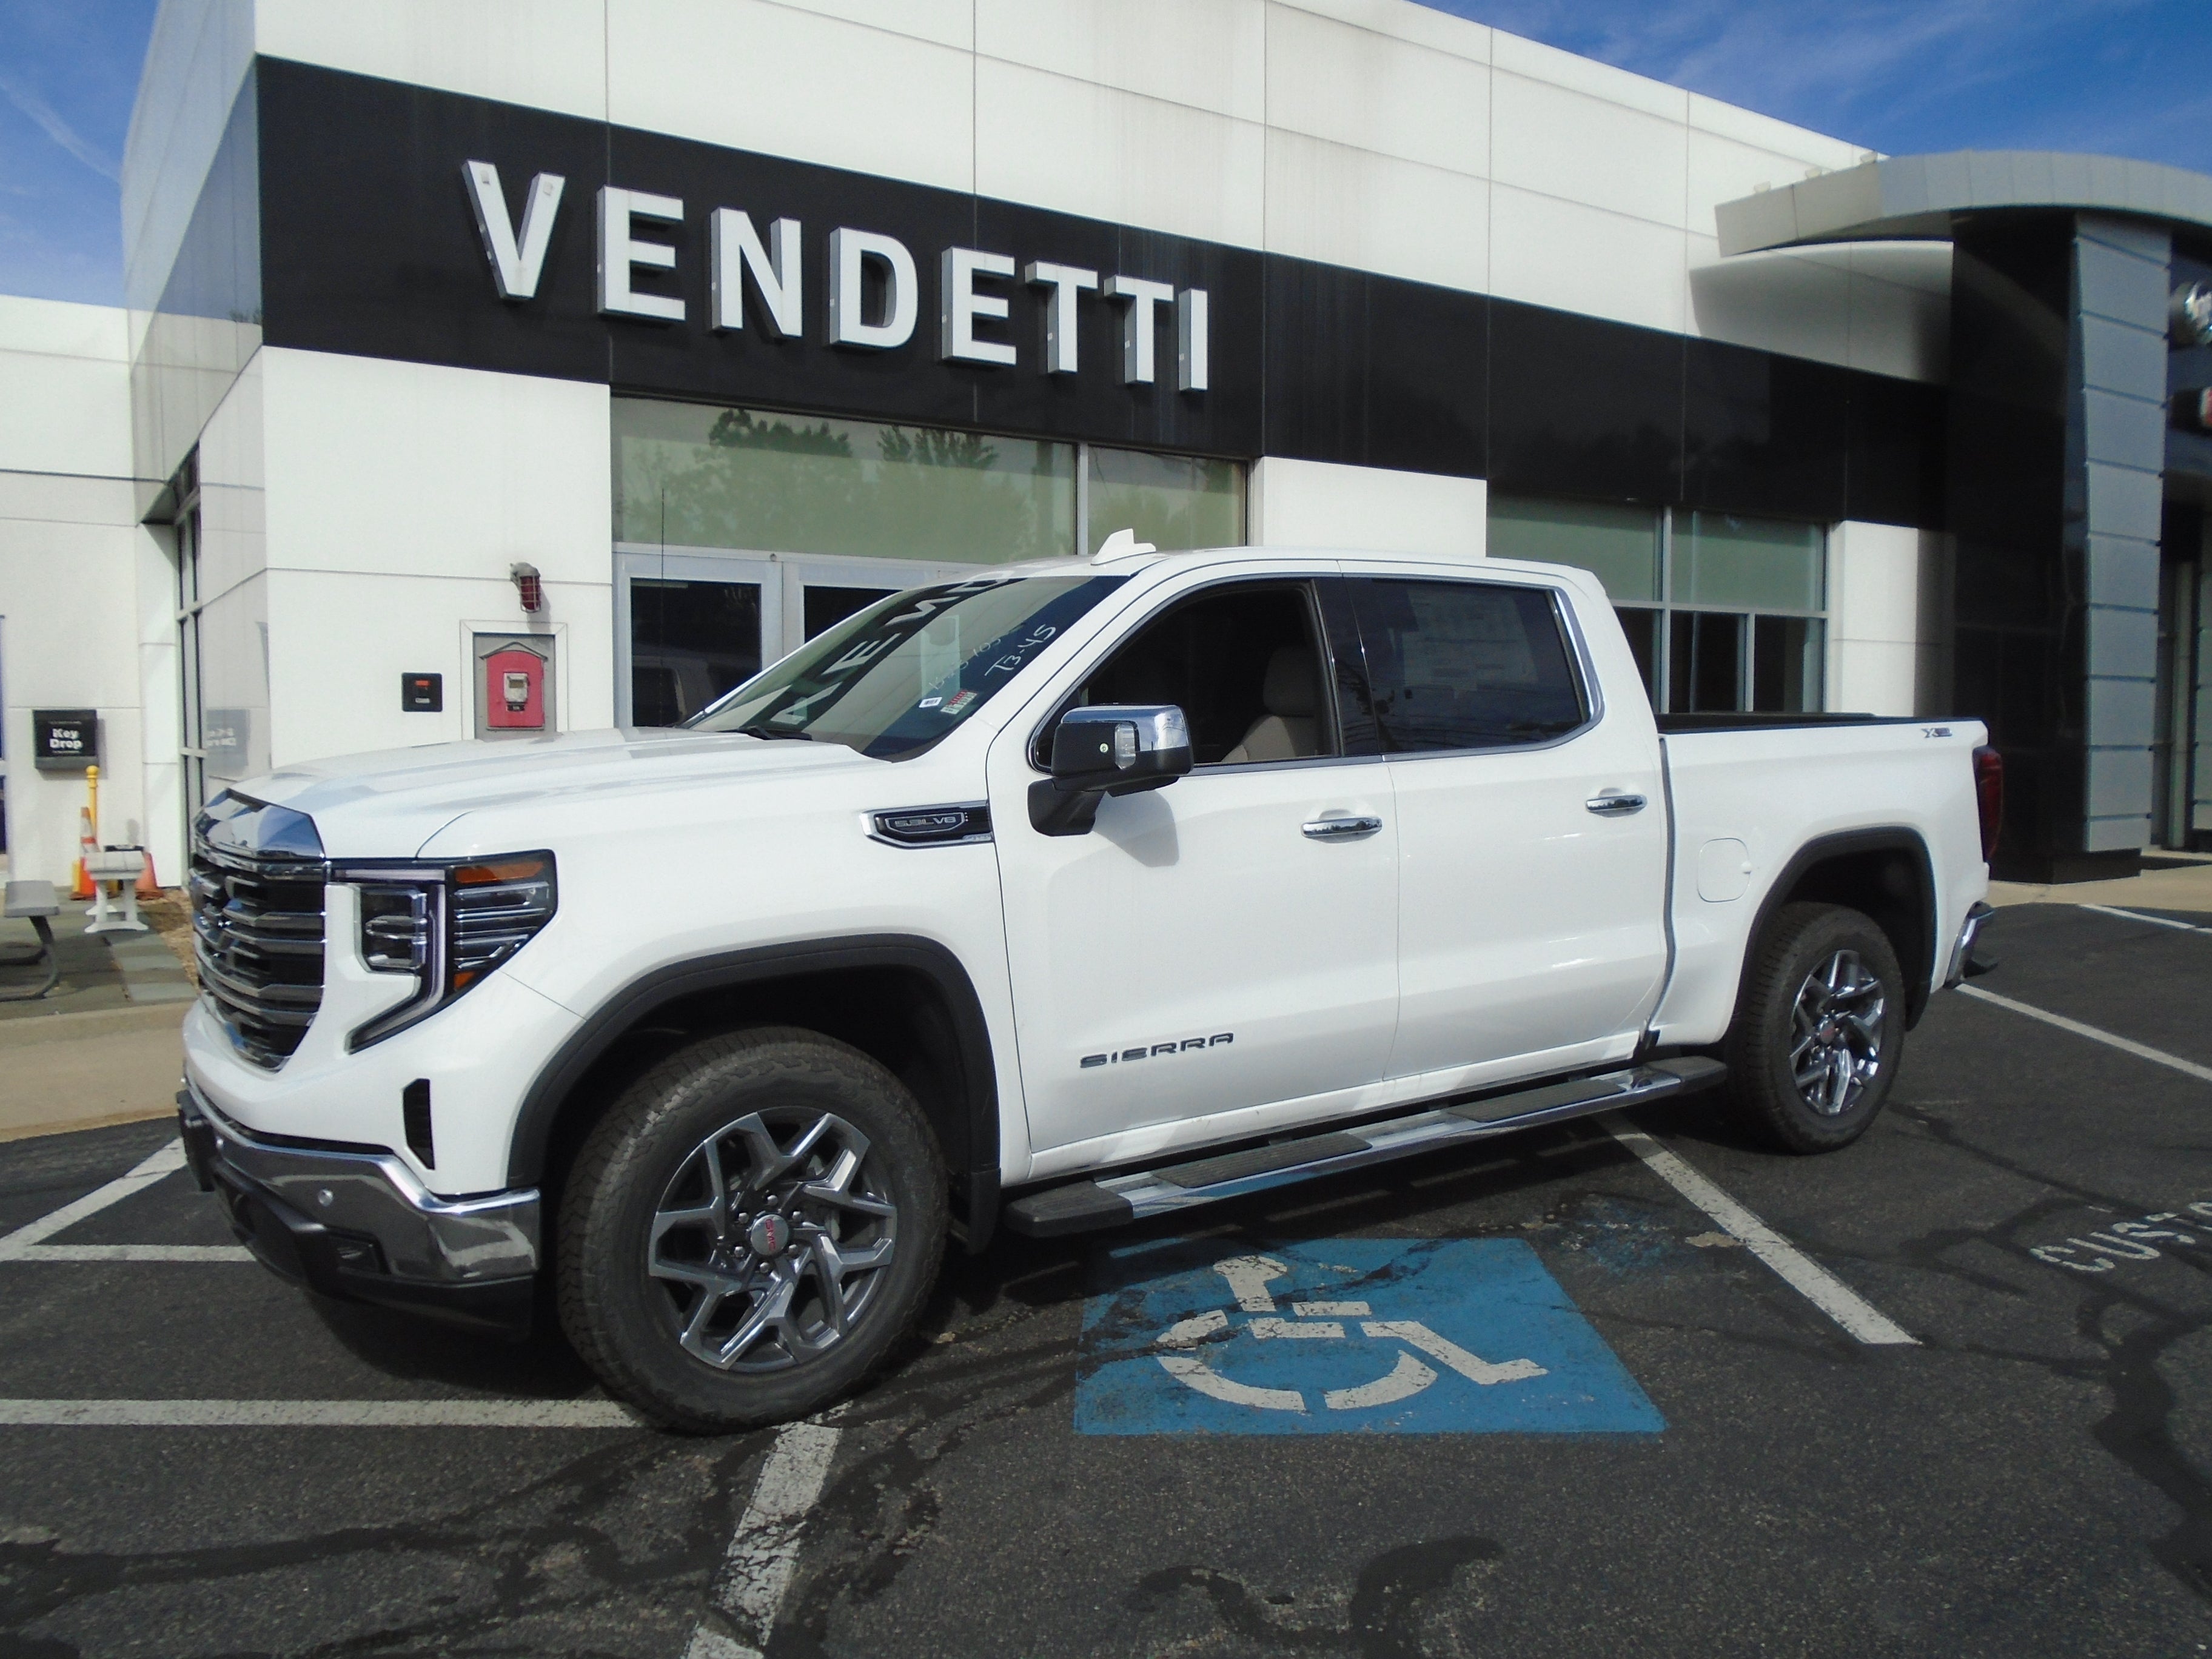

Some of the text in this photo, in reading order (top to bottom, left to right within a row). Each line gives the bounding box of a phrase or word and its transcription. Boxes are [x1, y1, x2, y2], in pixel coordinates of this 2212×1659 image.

[461, 159, 1209, 392] VENDETTI
[49, 738, 83, 749] Drop
[52, 728, 79, 739] Key
[1080, 1032, 1234, 1068] SIERRA
[765, 1219, 776, 1252] GMC
